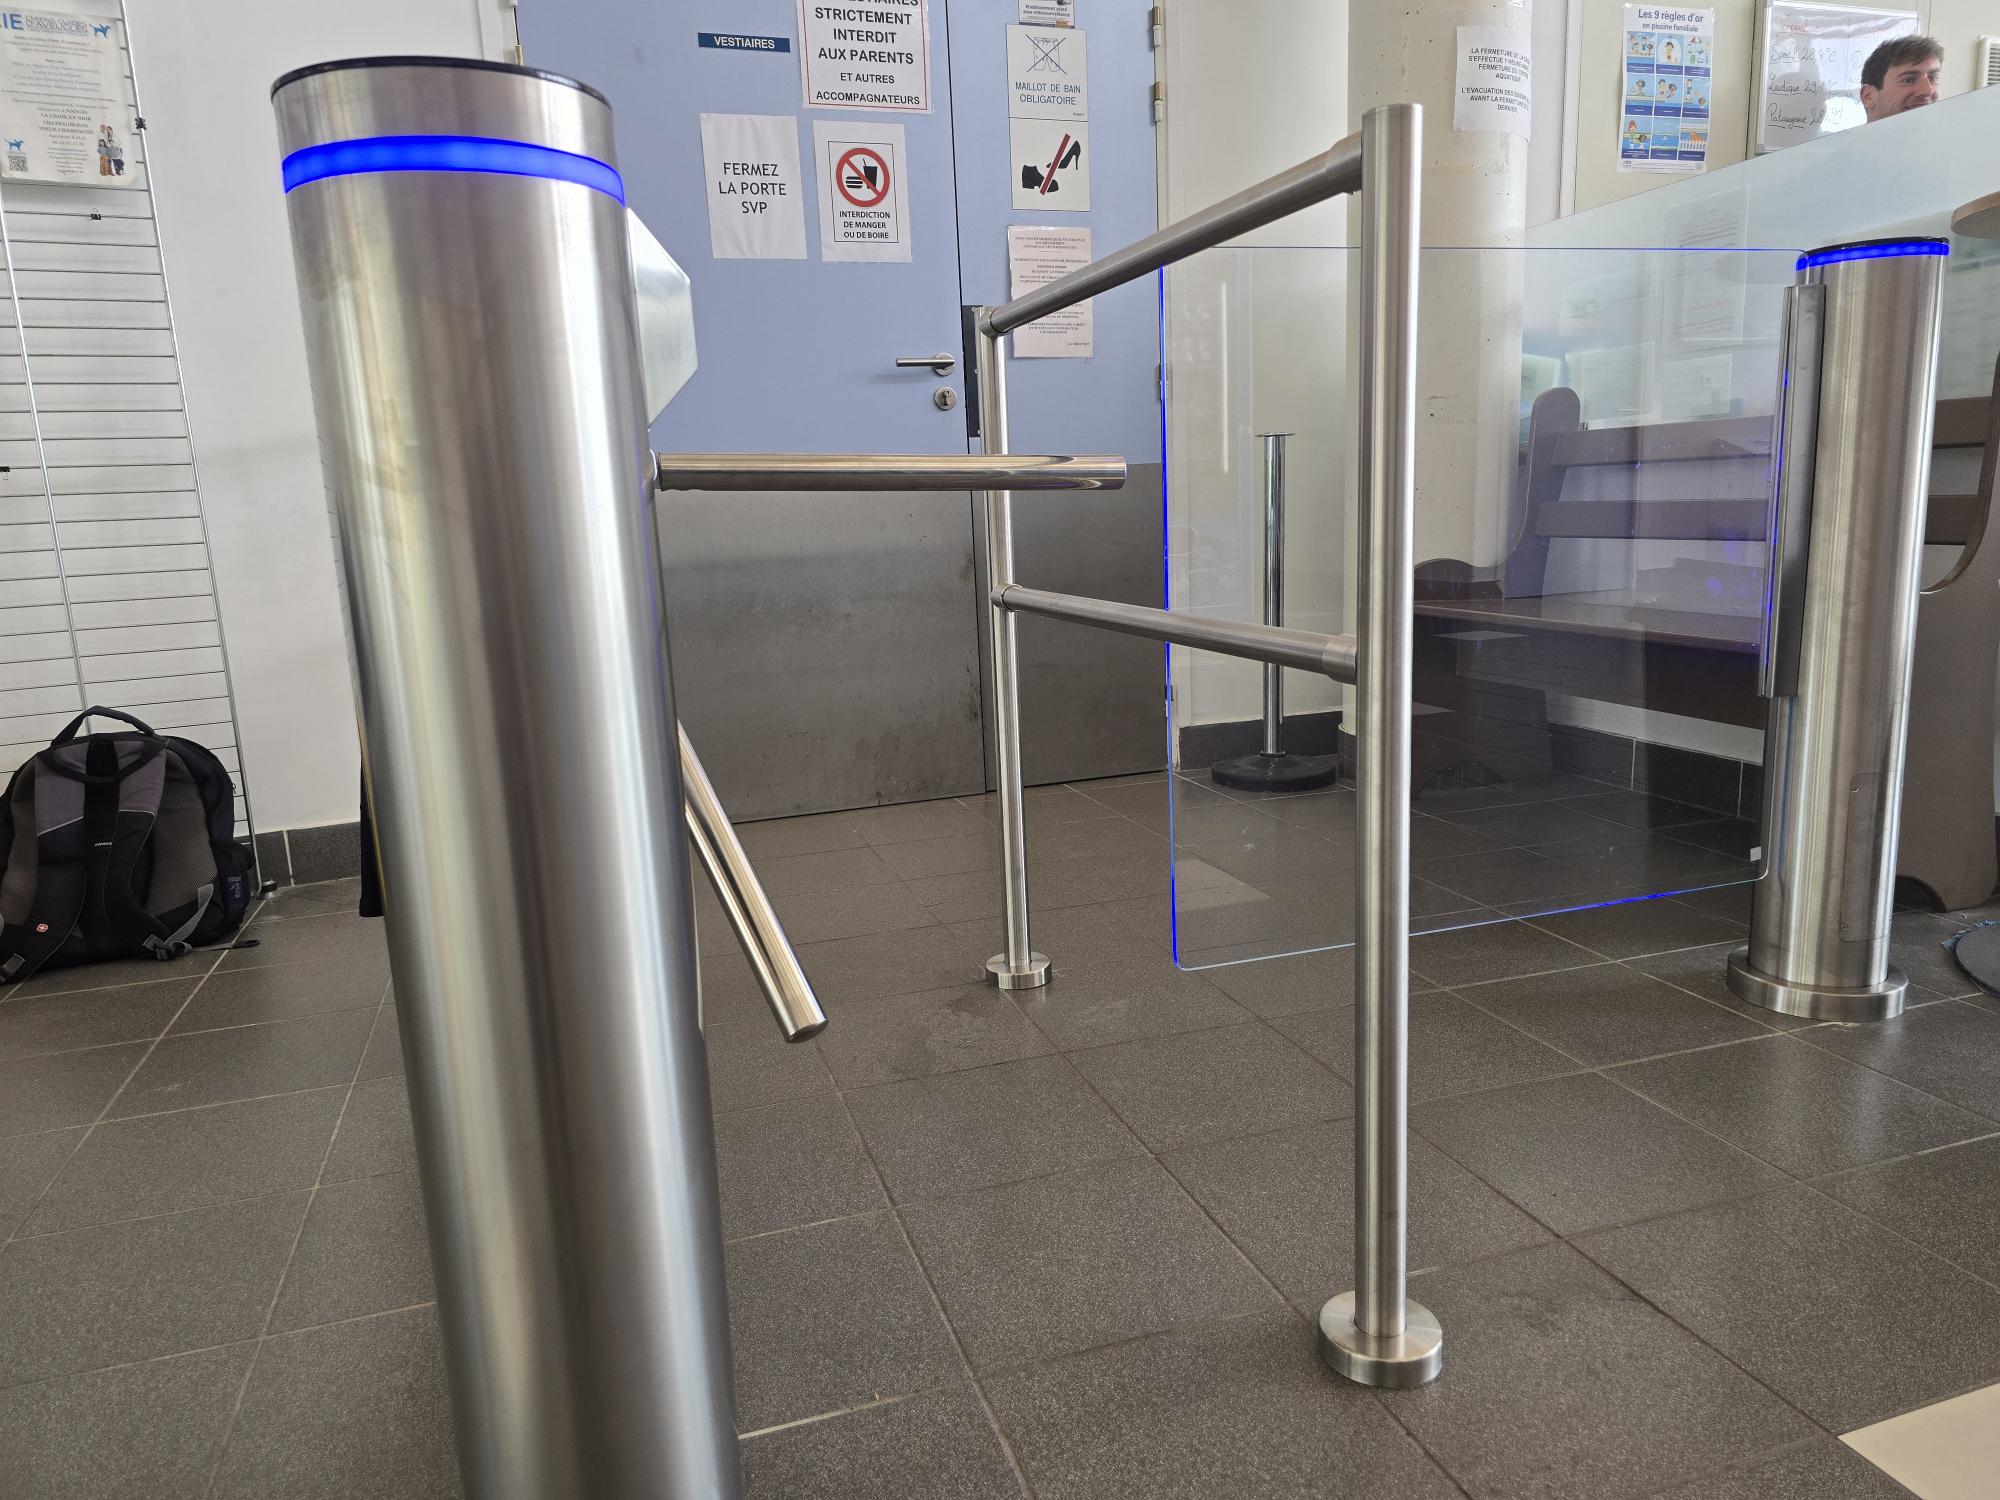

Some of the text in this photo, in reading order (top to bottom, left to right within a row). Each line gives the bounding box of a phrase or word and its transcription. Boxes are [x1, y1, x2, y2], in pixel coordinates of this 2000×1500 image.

[815, 7, 912, 24] STRICTEMENT
[1638, 9, 1652, 19] Les
[1654, 10, 1660, 19] 9
[1662, 11, 1686, 22] règles
[1652, 22, 1673, 31] piscine
[1674, 24, 1699, 32] familiale
[714, 36, 775, 49] VESTIAIRES
[833, 28, 897, 44] INTERDIT
[818, 47, 914, 64] AUX PARENTS
[1480, 48, 1513, 58] FERMETURE
[1478, 64, 1511, 72] FERMETURE
[840, 72, 895, 84] ET AUTRES
[1016, 82, 1081, 94] MAILLOT DE BAIN
[816, 91, 920, 105] ACCOMPAGNATEURS
[1020, 94, 1076, 105] OBLIGATOIRE
[724, 163, 779, 176] FERMEZ
[719, 182, 786, 195] LA PORTE
[742, 202, 768, 214] SVP
